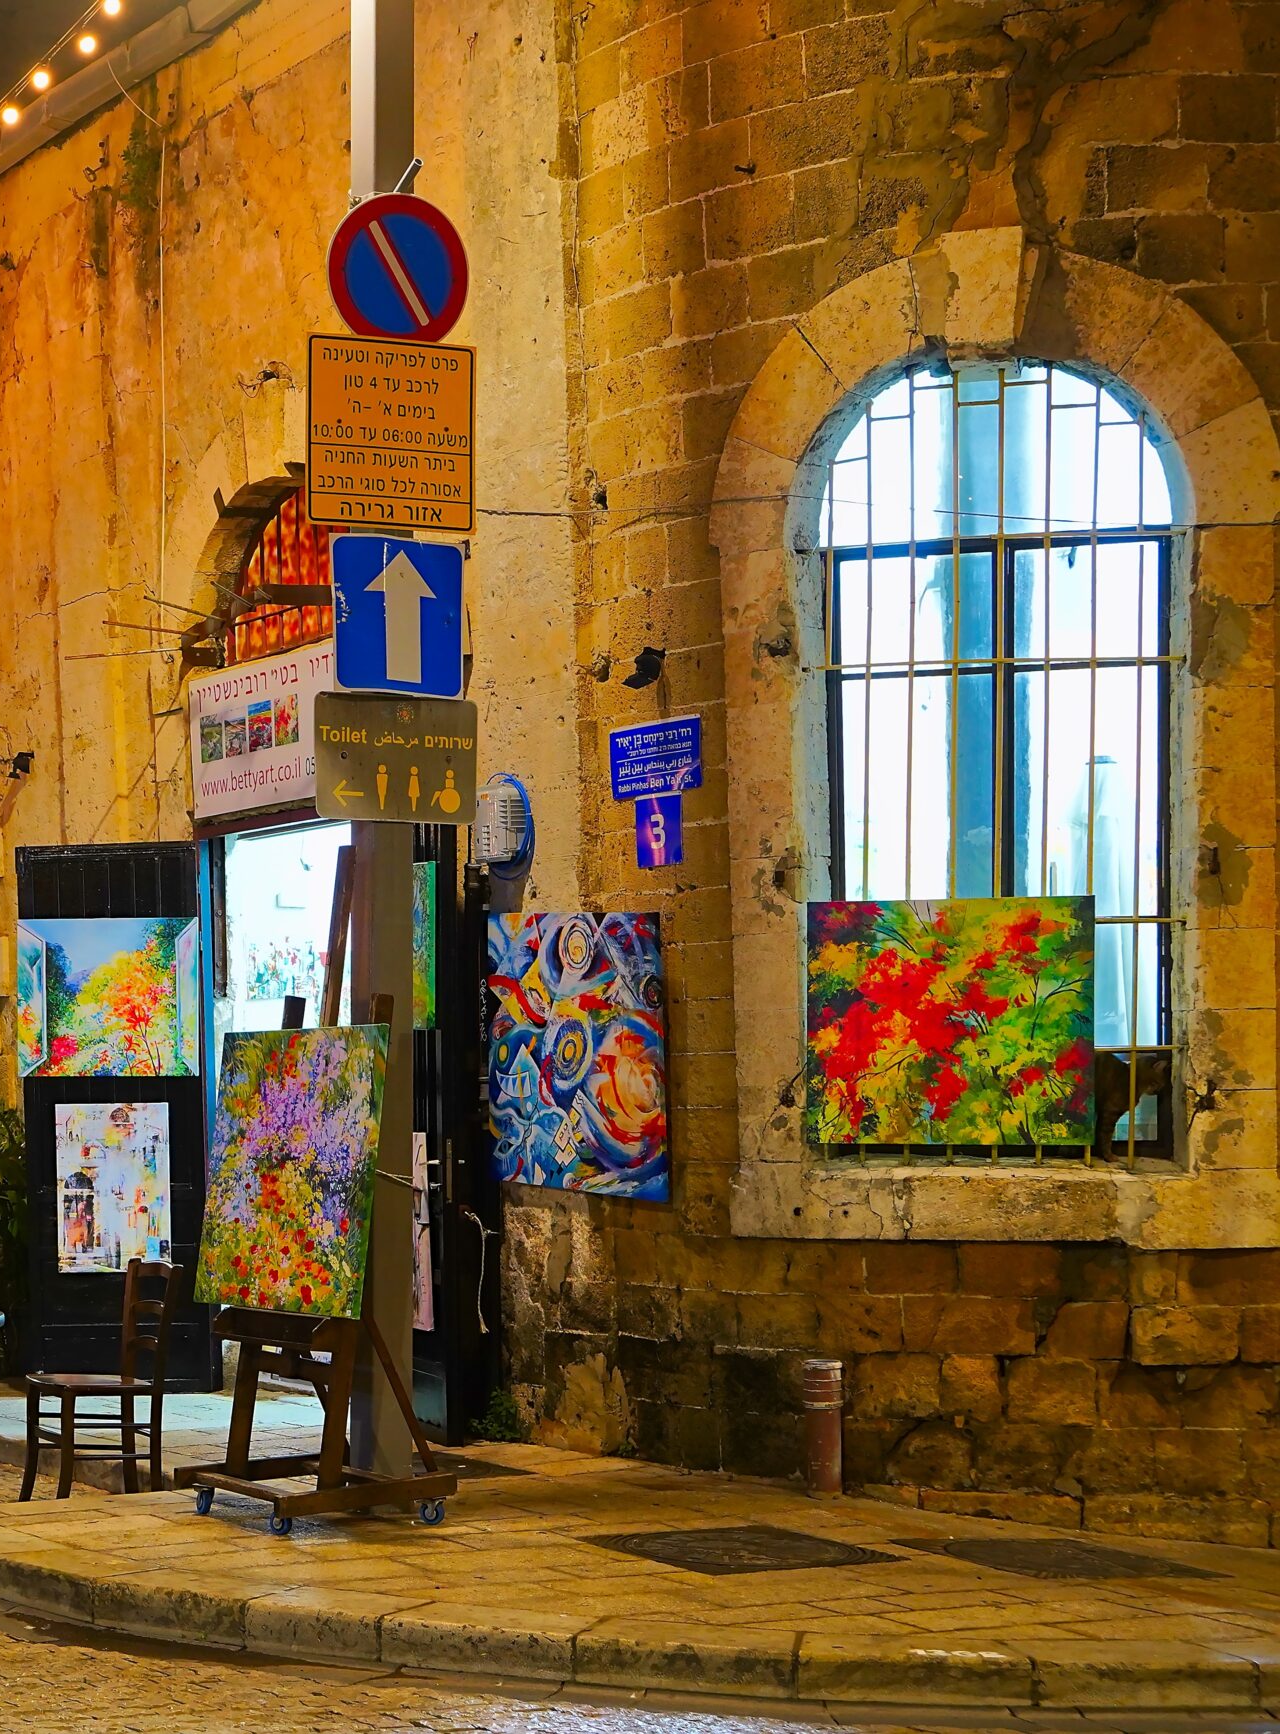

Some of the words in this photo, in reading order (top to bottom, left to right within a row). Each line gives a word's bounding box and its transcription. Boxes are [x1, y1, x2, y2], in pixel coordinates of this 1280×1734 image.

[322, 347, 369, 364] וטעינה
[375, 350, 426, 369] לפריקה
[431, 356, 459, 372] פרט
[344, 374, 363, 391] טון
[369, 376, 378, 389] 4
[383, 377, 401, 392] עד
[406, 378, 439, 395] לרכב
[397, 403, 436, 420] בימים
[313, 423, 354, 439] 10:00
[359, 426, 377, 441] עד
[382, 428, 423, 444] 06:00
[427, 431, 468, 448] משעה
[324, 449, 366, 465] החניה
[372, 452, 419, 469] השעות
[424, 456, 456, 472] ביתר
[317, 474, 354, 490] הרכב
[360, 477, 386, 492] סוגי
[391, 477, 416, 494] לכל
[420, 481, 461, 498] אסורה
[340, 501, 394, 519] גרירה
[403, 505, 442, 523] אזור
[309, 653, 335, 678] דיו
[319, 725, 368, 744] Toilet
[374, 731, 419, 749] مرحاض
[424, 735, 473, 750] שרותים
[201, 756, 301, 798] www.bettyart.co.il
[305, 756, 316, 776] 05
[650, 777, 664, 788] Ben
[650, 813, 666, 850] 3
